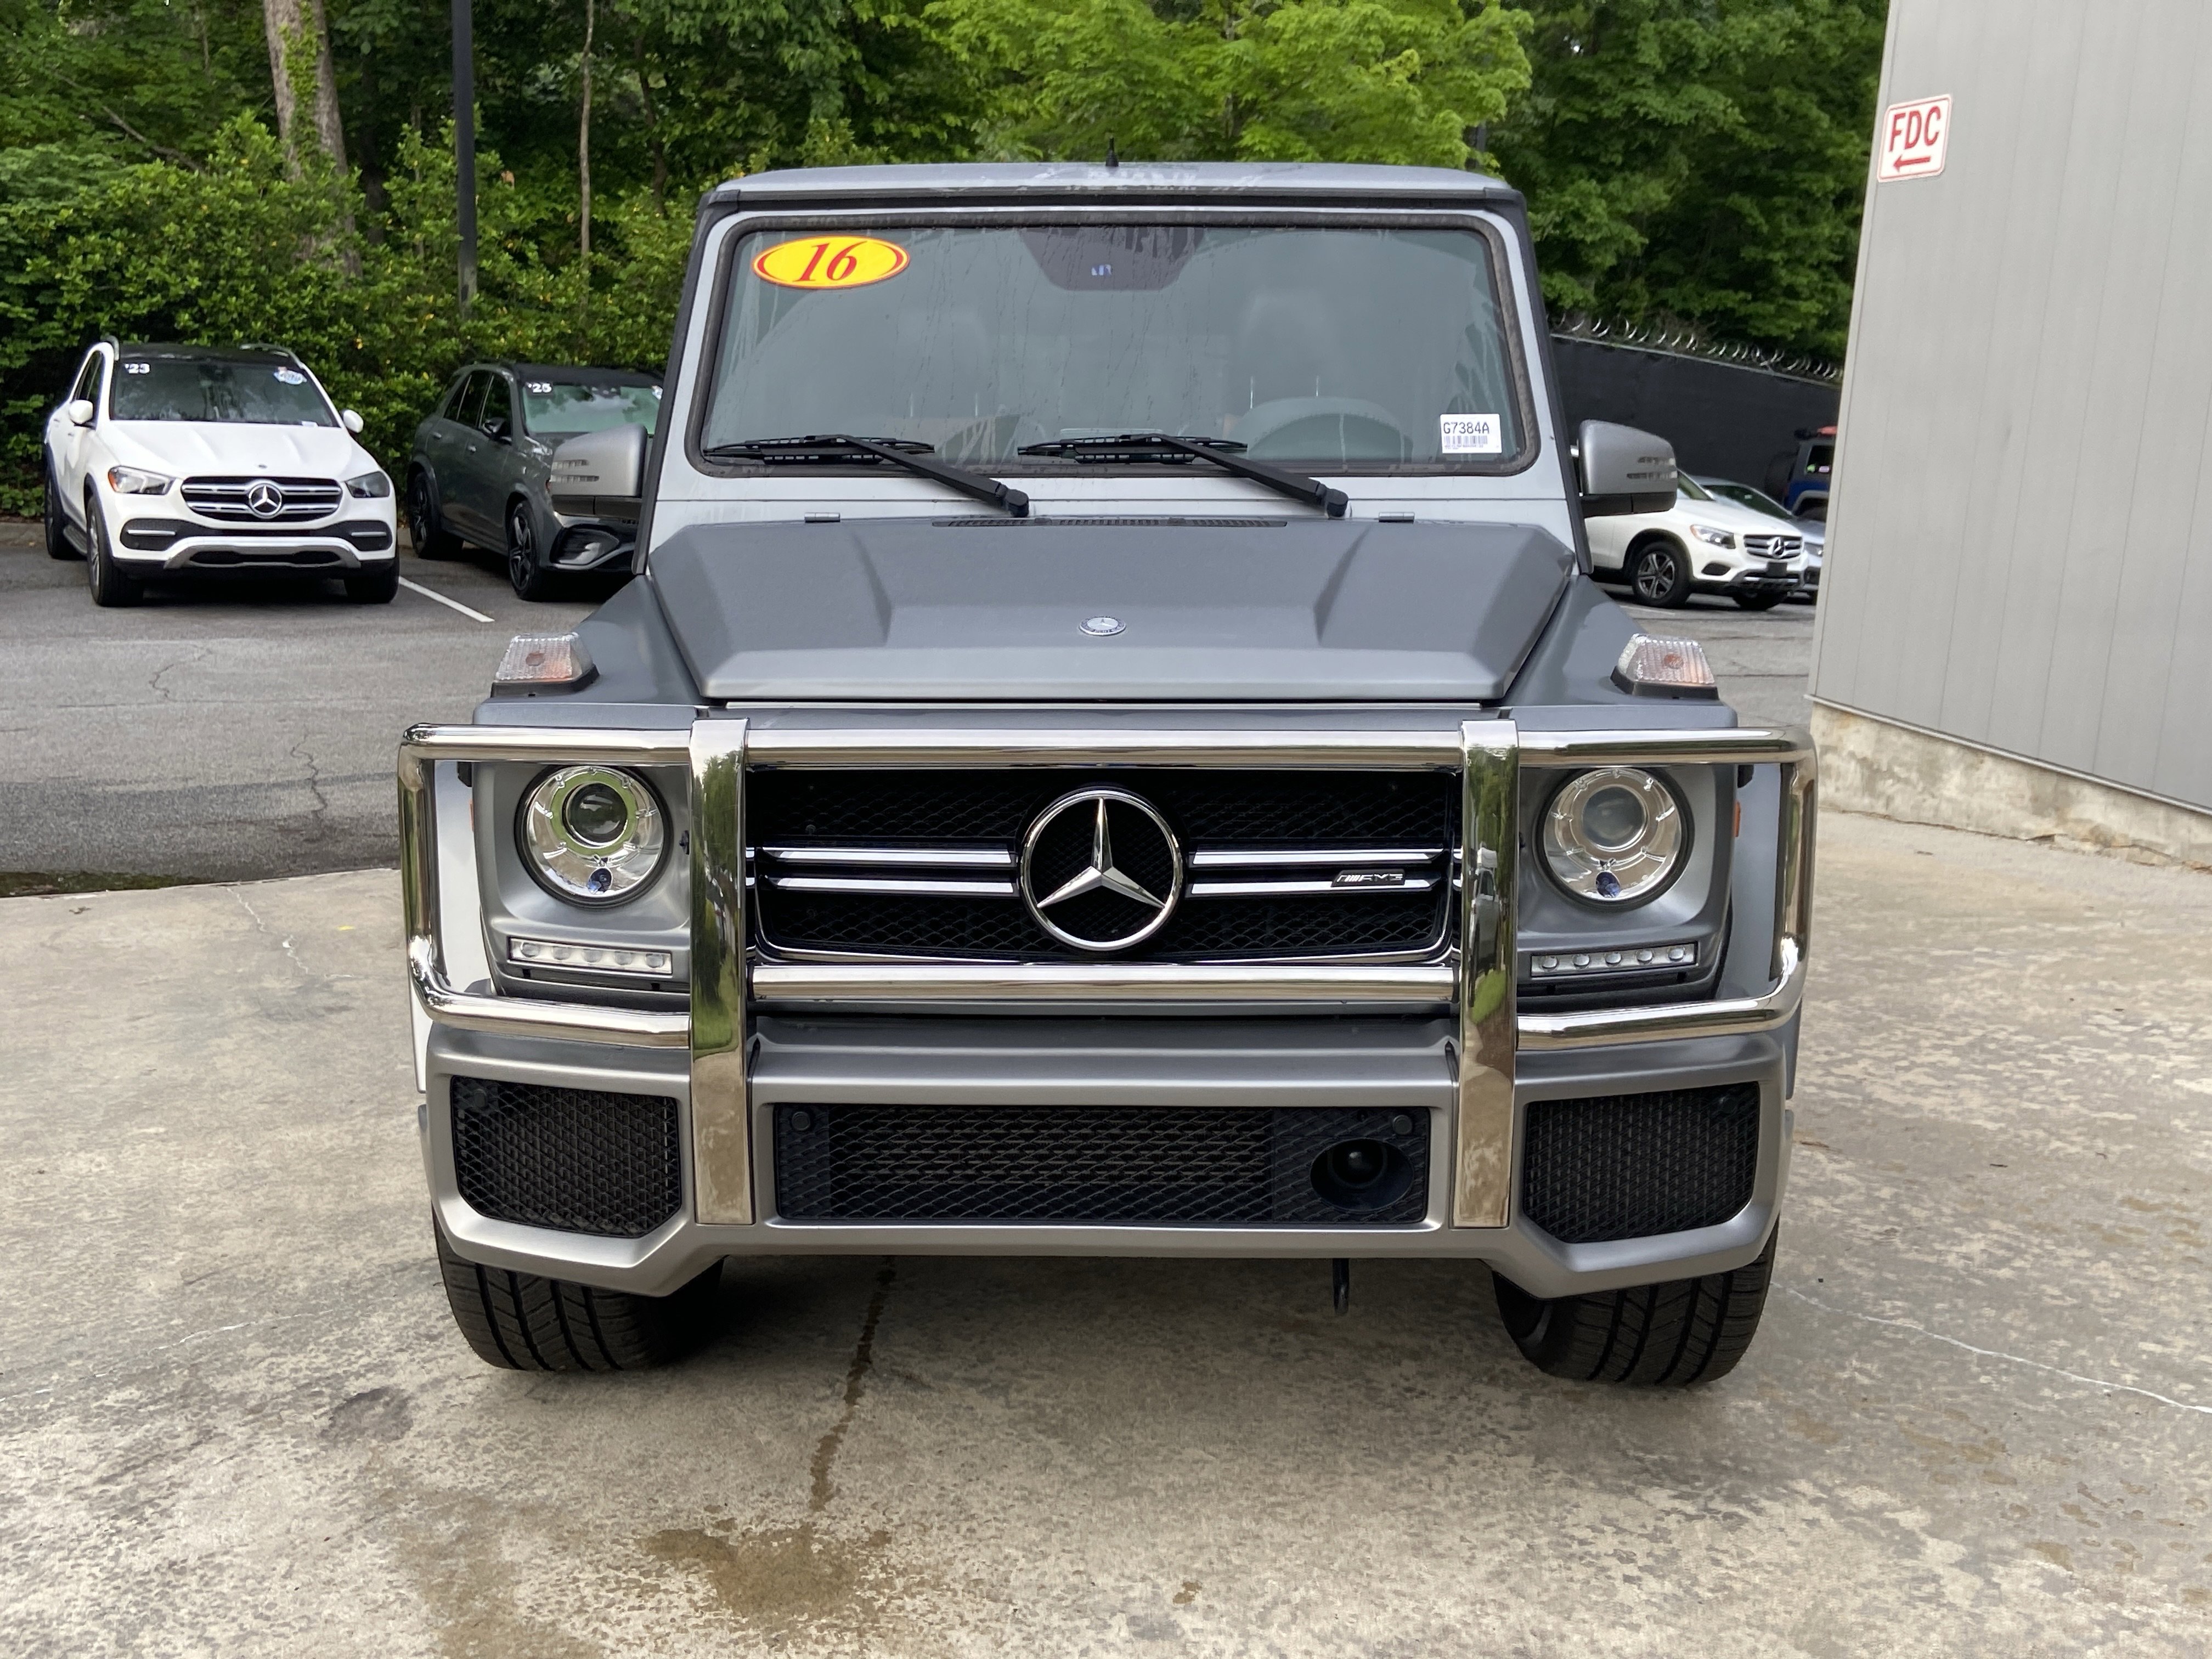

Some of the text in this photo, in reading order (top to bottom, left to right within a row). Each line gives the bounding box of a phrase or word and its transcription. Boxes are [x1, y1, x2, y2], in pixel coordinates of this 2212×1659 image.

[1888, 105, 1942, 153] FDC
[792, 241, 868, 281] 16
[1443, 421, 1490, 435] G7384A
